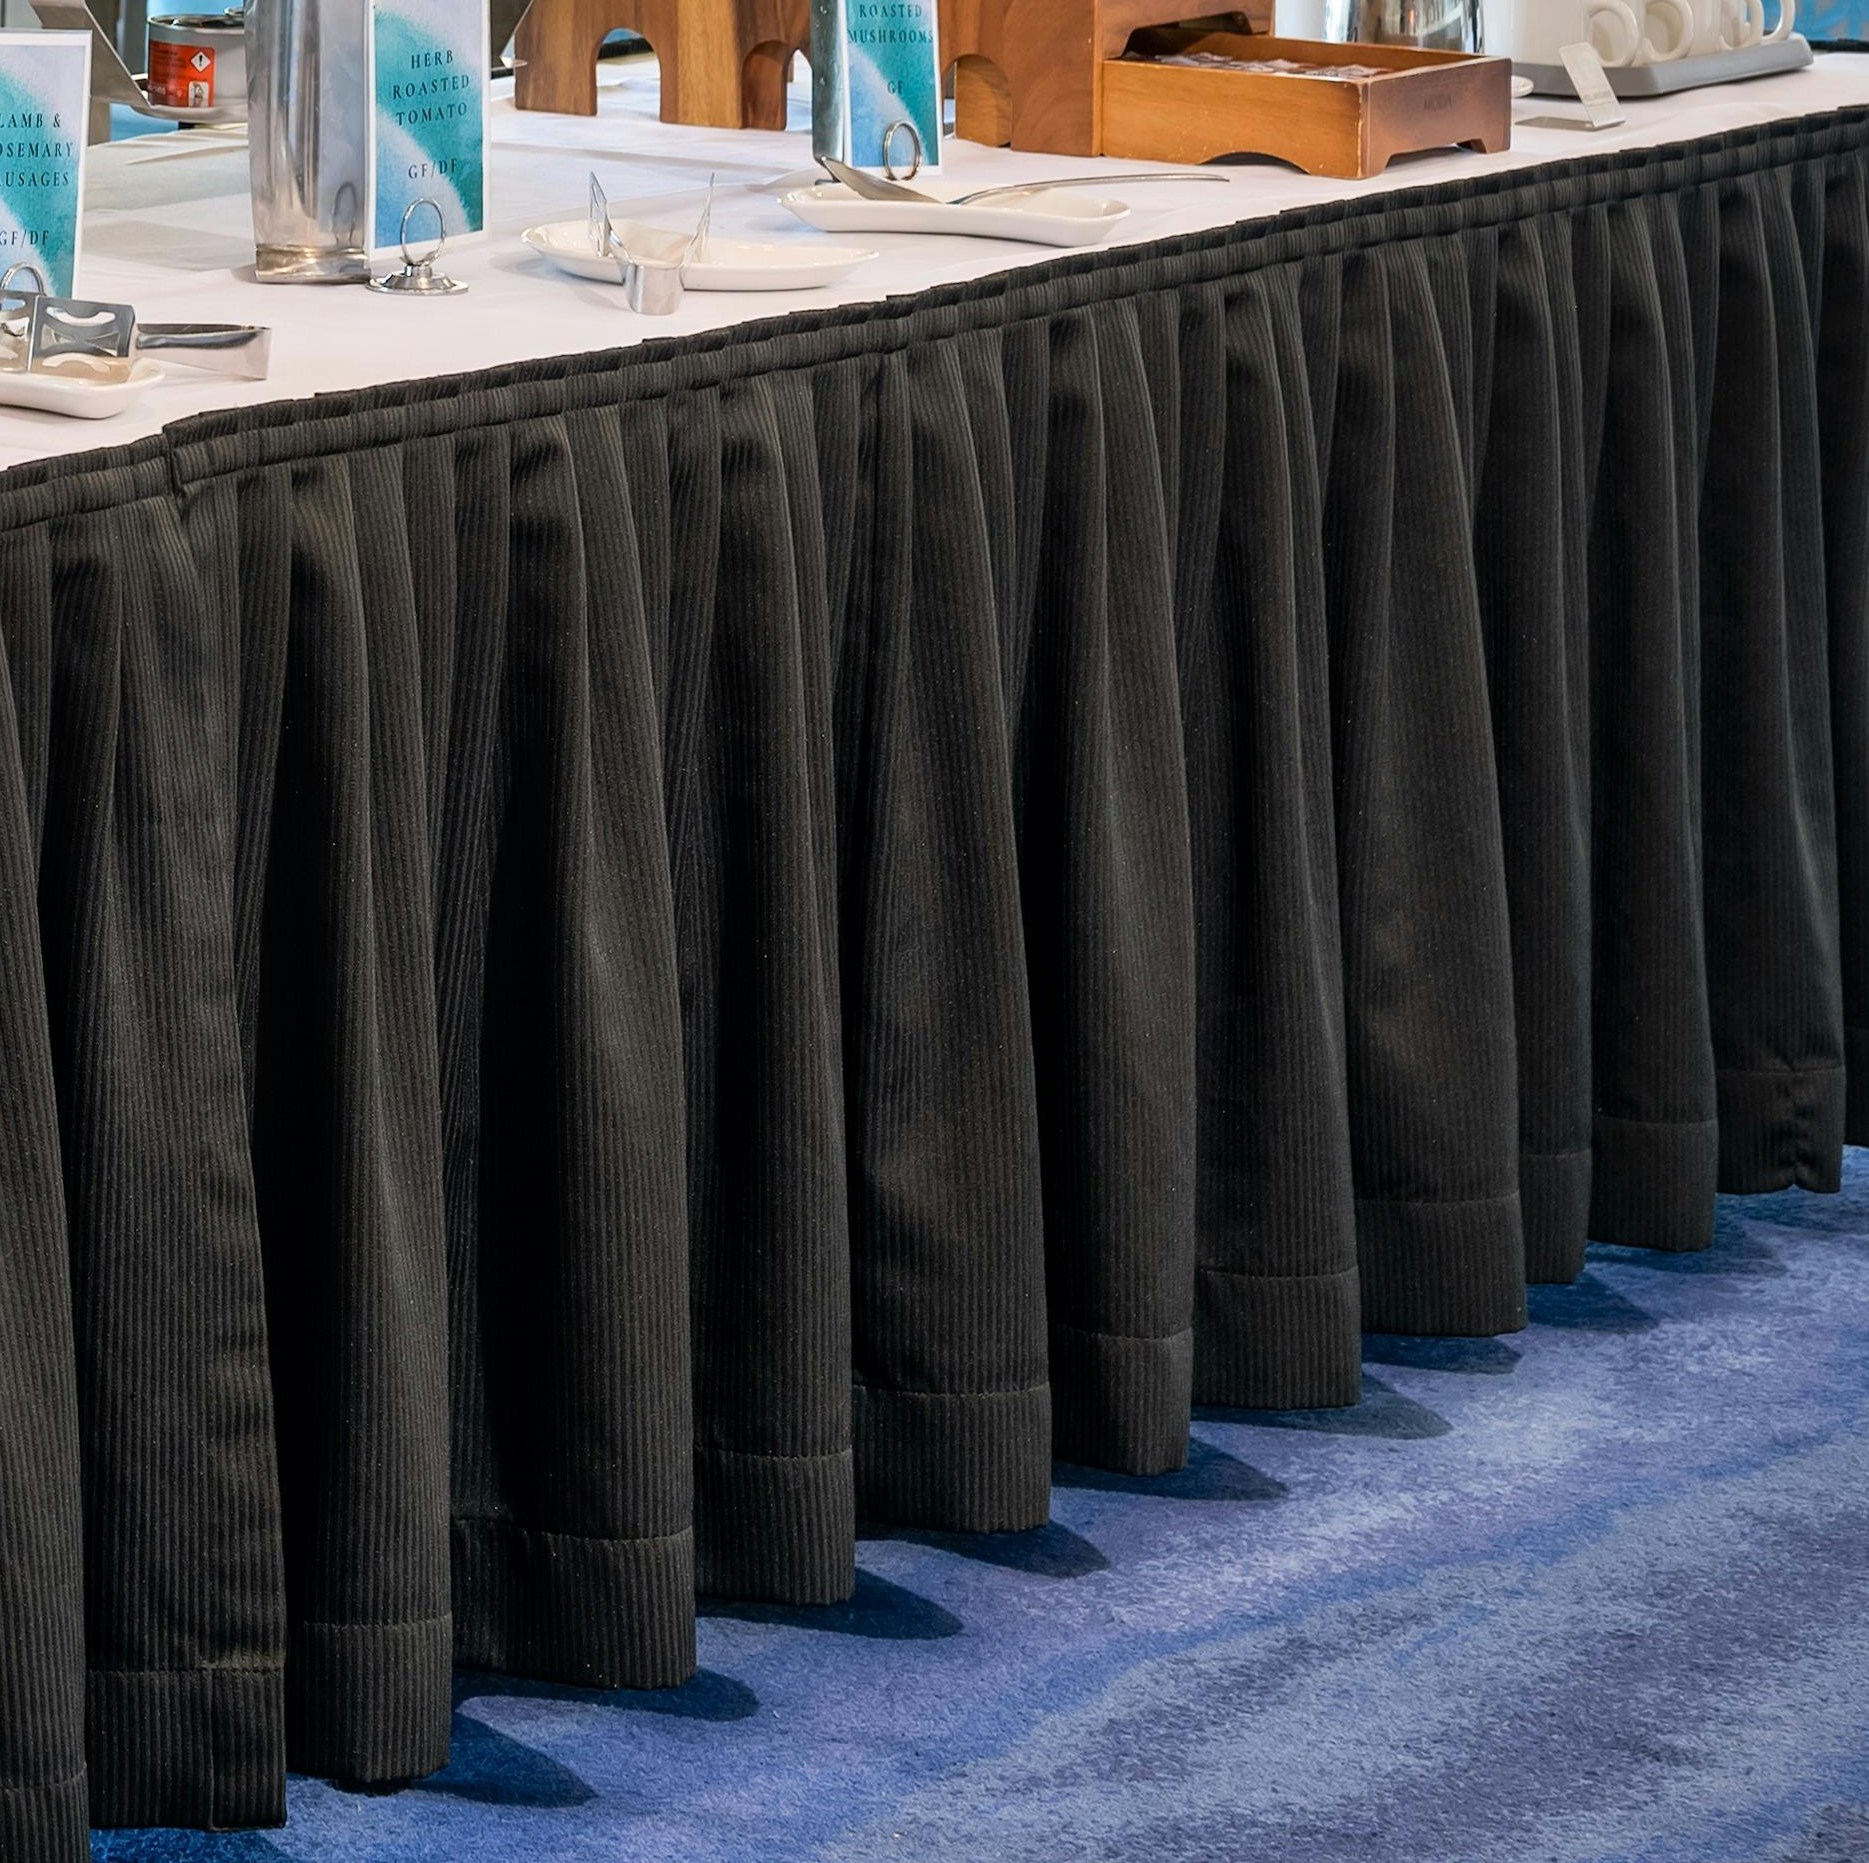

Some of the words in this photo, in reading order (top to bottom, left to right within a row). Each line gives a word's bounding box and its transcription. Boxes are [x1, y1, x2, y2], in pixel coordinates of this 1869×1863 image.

[859, 3, 923, 18] ROASTED
[847, 28, 934, 44] MUSHROOMS
[411, 50, 454, 70] HERB
[392, 73, 470, 100] ROASTED
[887, 80, 903, 96] GF
[52, 112, 62, 128] &
[396, 101, 468, 126] TOMATO
[408, 157, 458, 180] GF/DF
